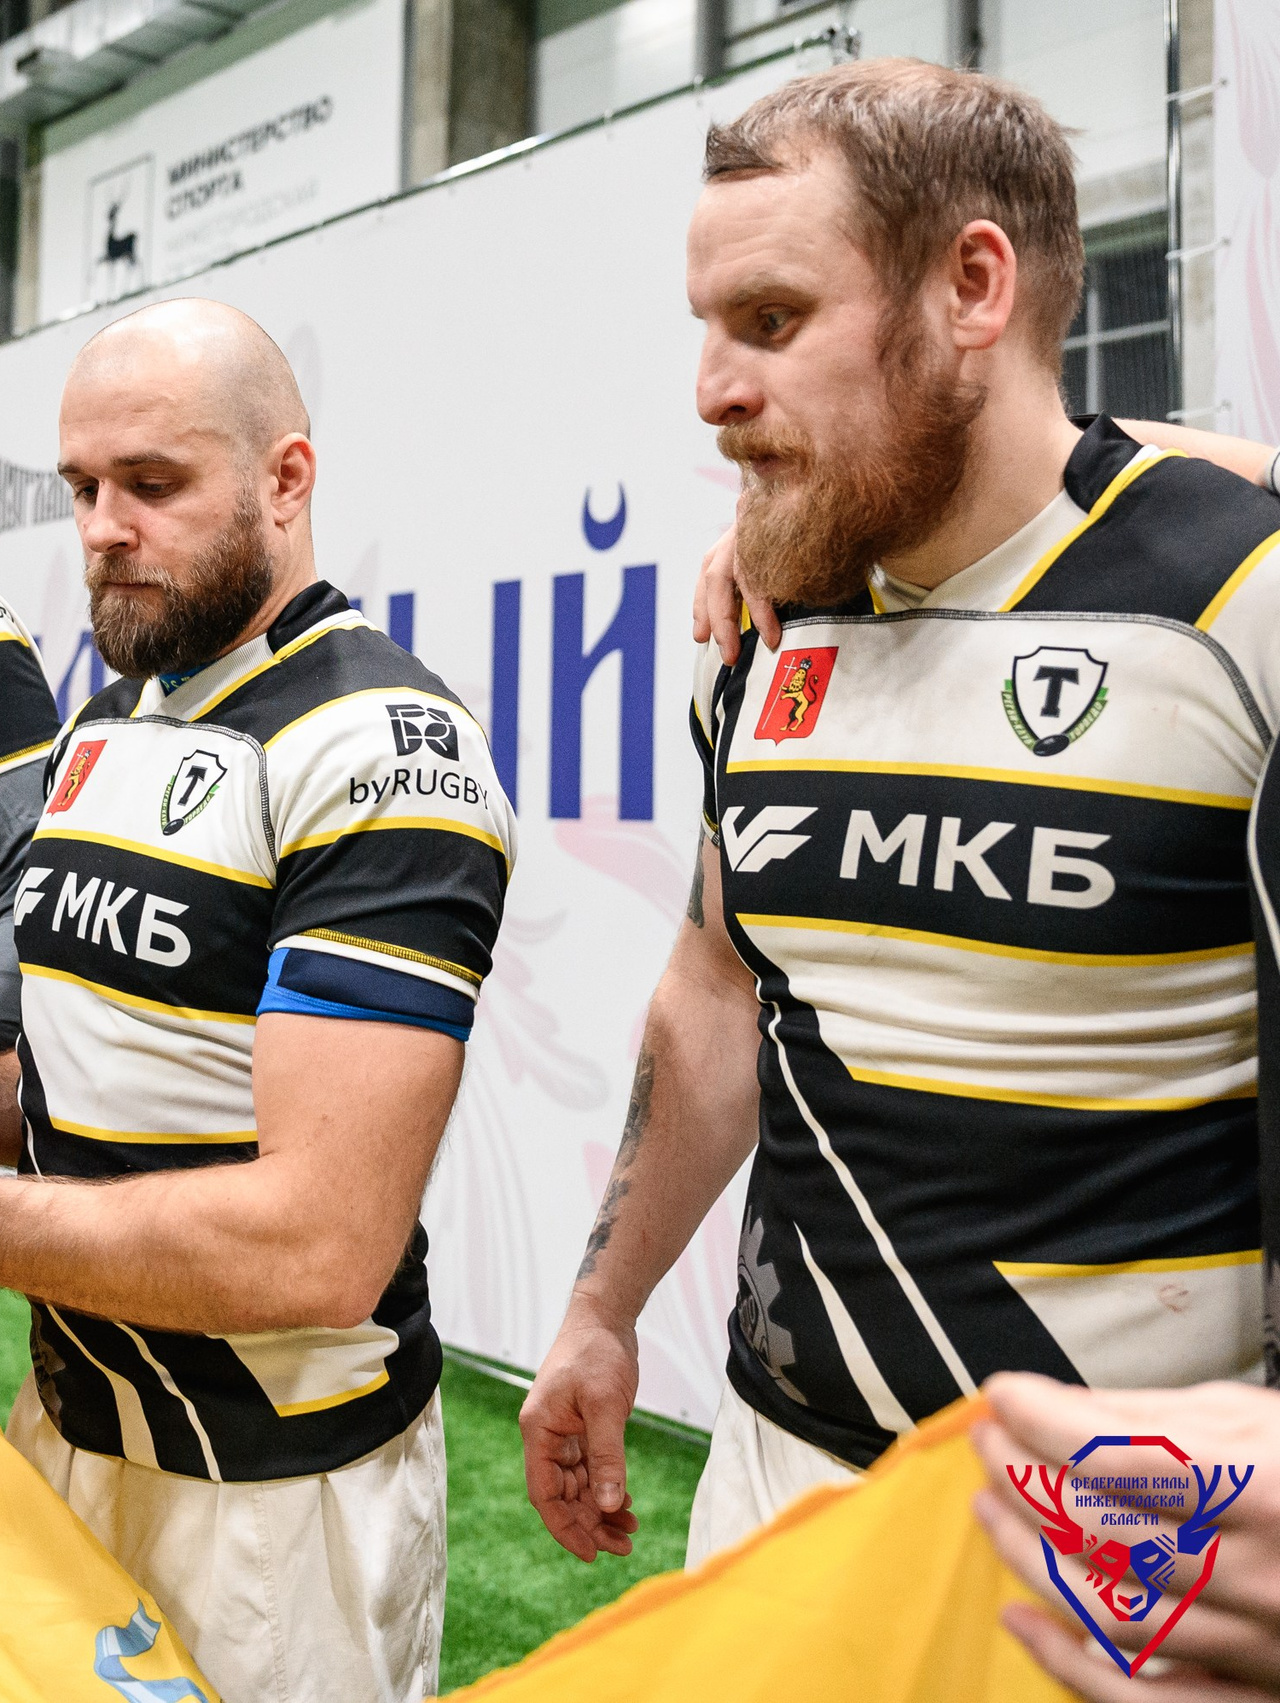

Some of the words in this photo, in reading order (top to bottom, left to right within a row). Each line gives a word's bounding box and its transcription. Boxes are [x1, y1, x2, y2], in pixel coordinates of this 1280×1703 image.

[349, 768, 488, 810] byRUGBY
[839, 809, 1116, 909] МКБ
[52, 871, 191, 967] МКБ
